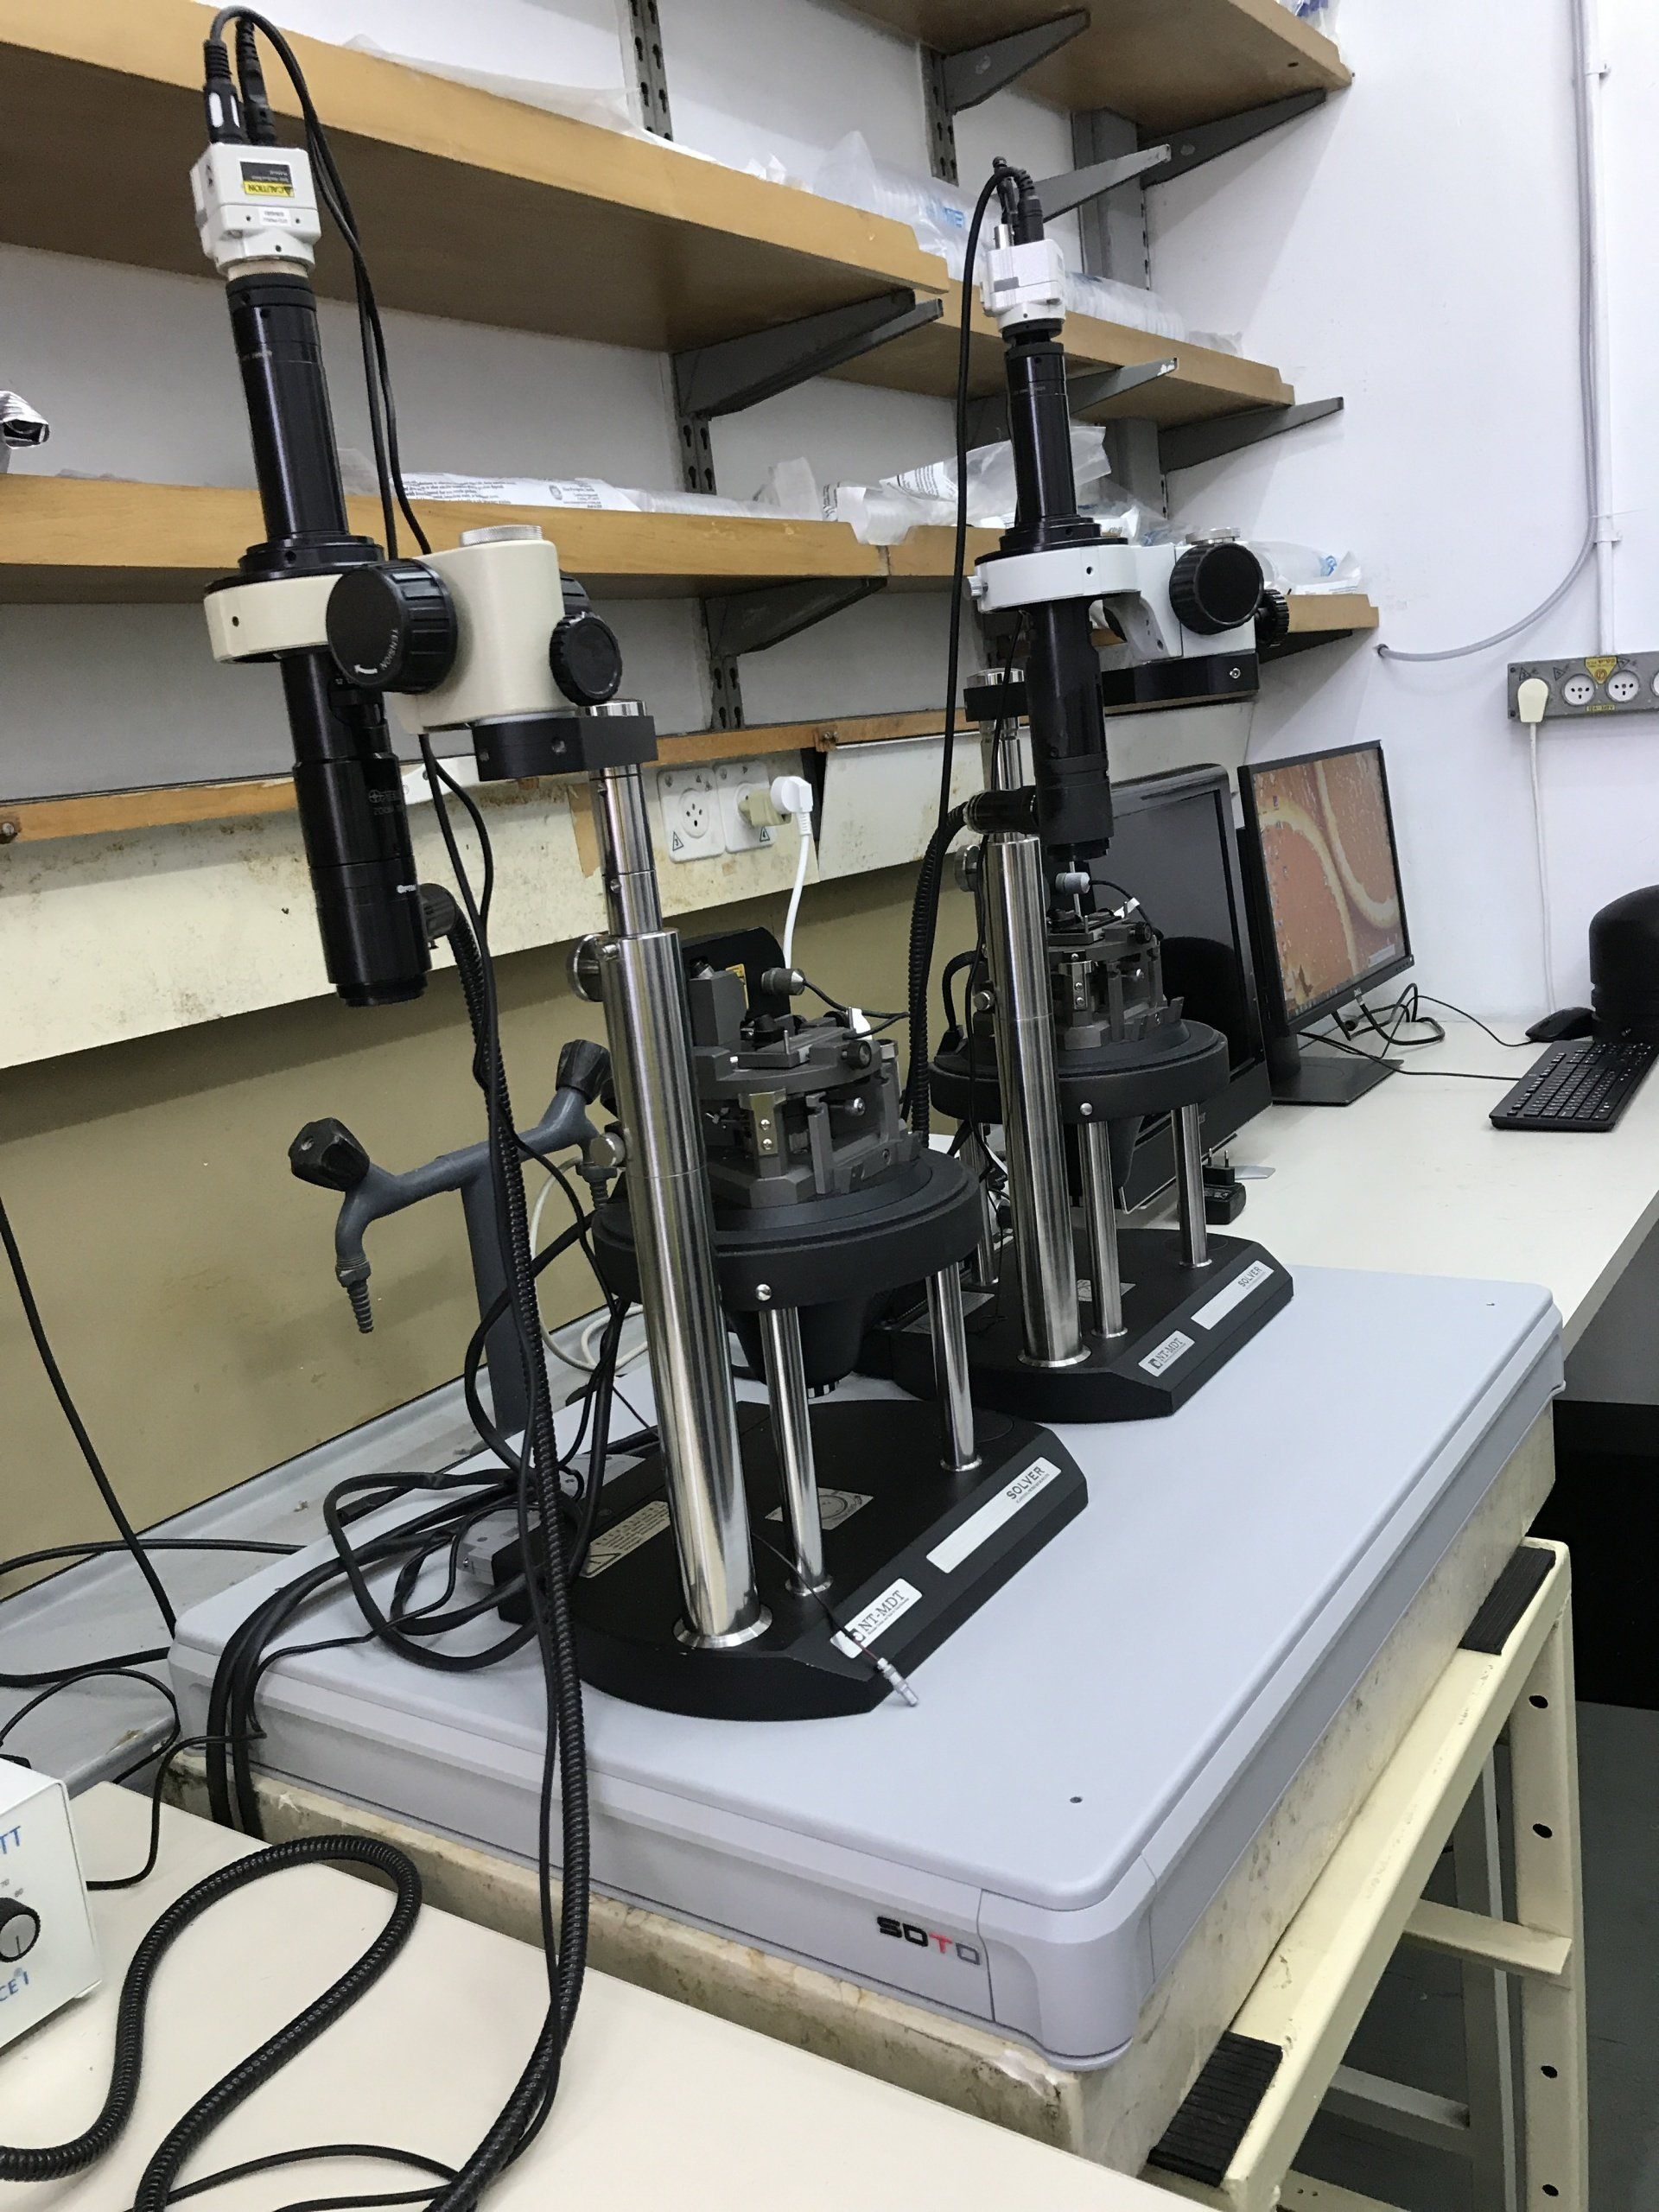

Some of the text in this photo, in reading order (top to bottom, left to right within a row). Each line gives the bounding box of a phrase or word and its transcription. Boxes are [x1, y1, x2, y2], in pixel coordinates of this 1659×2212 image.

[248, 184, 283, 194] CAUTION
[379, 628, 399, 671] TENSION
[1237, 1266, 1262, 1287] SOLVER
[1155, 1337, 1184, 1362] NT-MDT
[1006, 1465, 1046, 1500] SOLVER
[857, 1589, 906, 1631] NT-MDT
